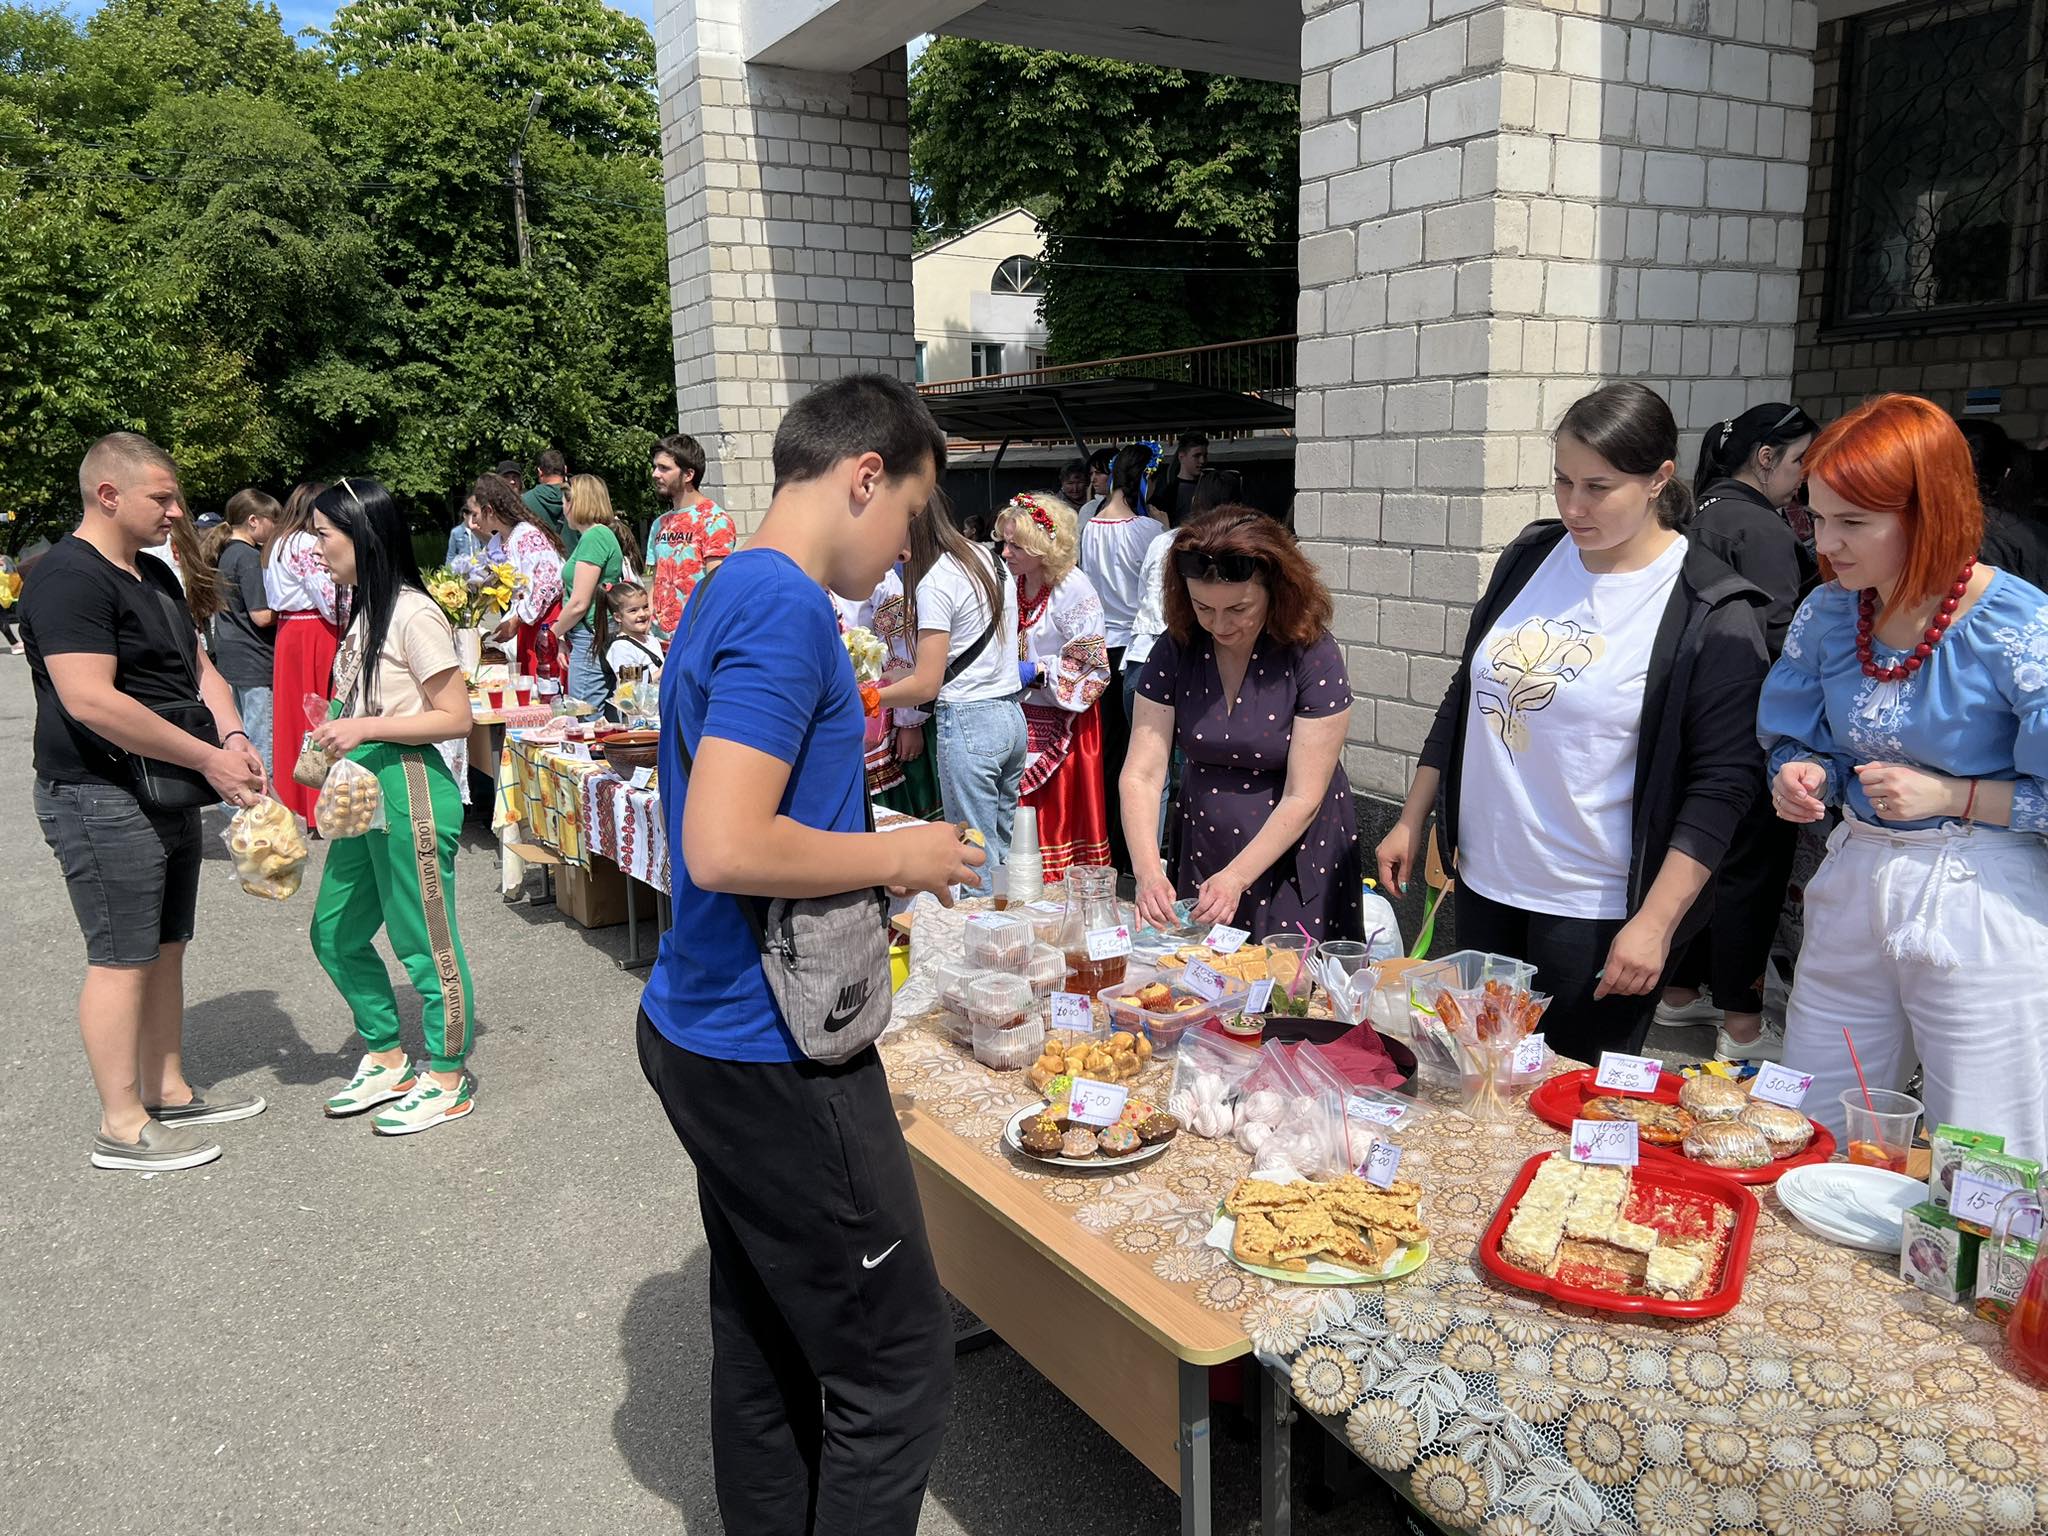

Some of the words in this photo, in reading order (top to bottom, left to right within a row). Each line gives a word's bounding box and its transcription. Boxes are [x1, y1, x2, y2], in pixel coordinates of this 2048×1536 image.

[656, 532, 693, 544] HAWAII
[417, 820, 432, 849] LOUIS
[423, 860, 439, 899] VUITTON
[439, 947, 454, 976] LOUIS
[448, 985, 462, 1024] VUITTON
[835, 977, 869, 1012] NIKE
[1080, 1091, 1111, 1106] 5-00
[1597, 1122, 1629, 1132] 10-00
[1989, 1284, 2011, 1298] Наш
